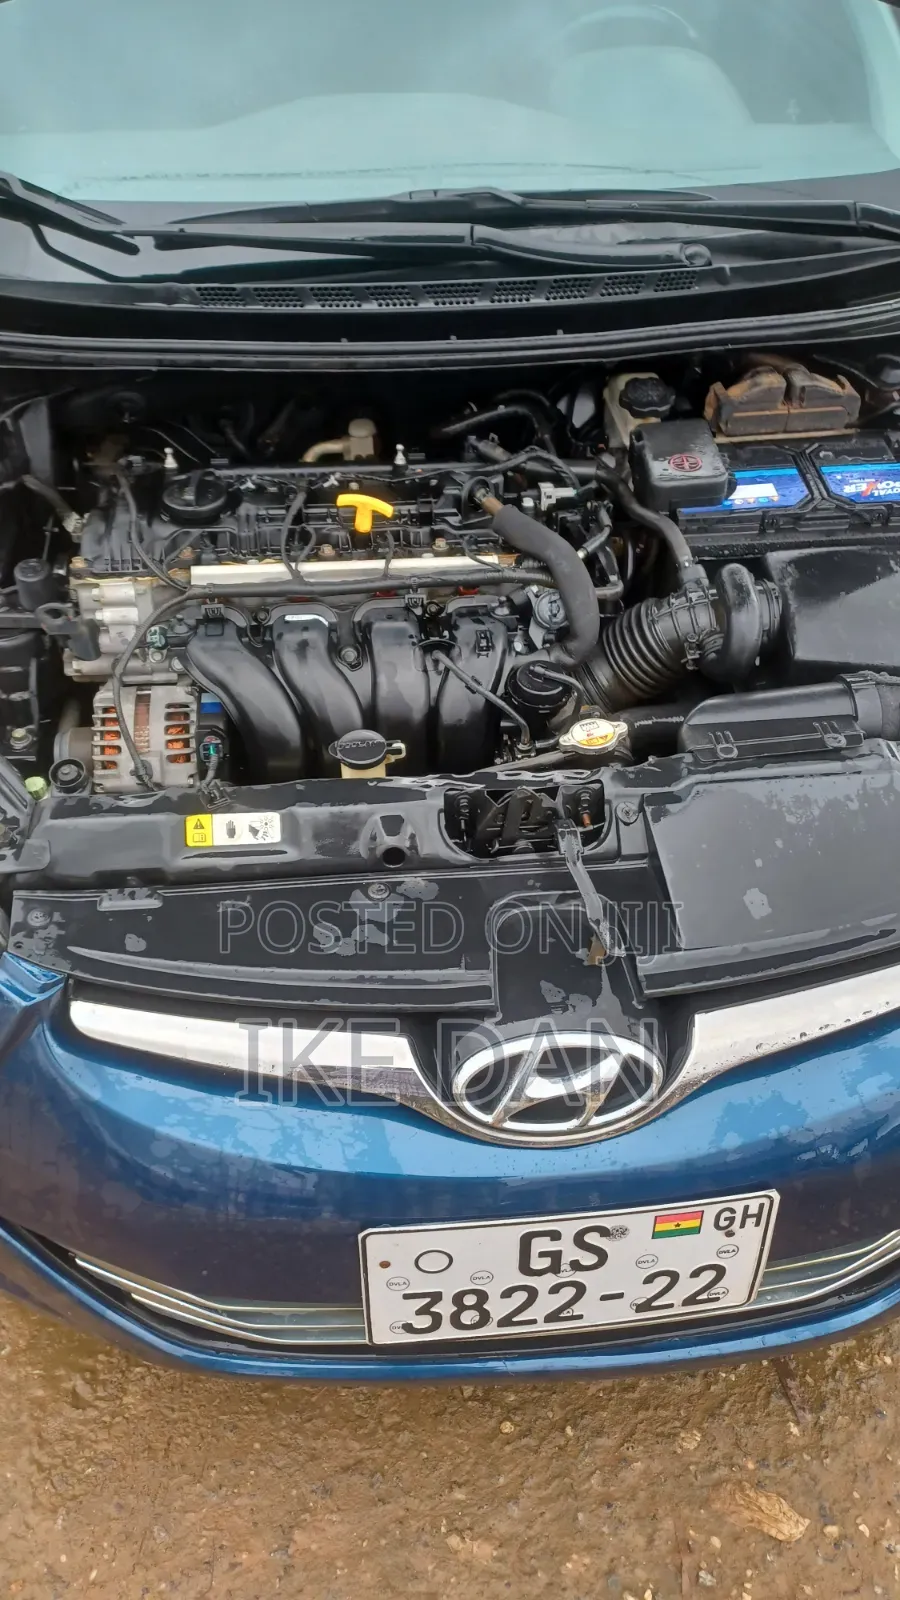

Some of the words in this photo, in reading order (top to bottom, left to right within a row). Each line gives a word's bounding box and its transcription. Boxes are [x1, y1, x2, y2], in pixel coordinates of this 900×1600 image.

[713, 1202, 765, 1231] GH
[518, 1225, 609, 1278] GS
[402, 1264, 727, 1335] 3822-22
